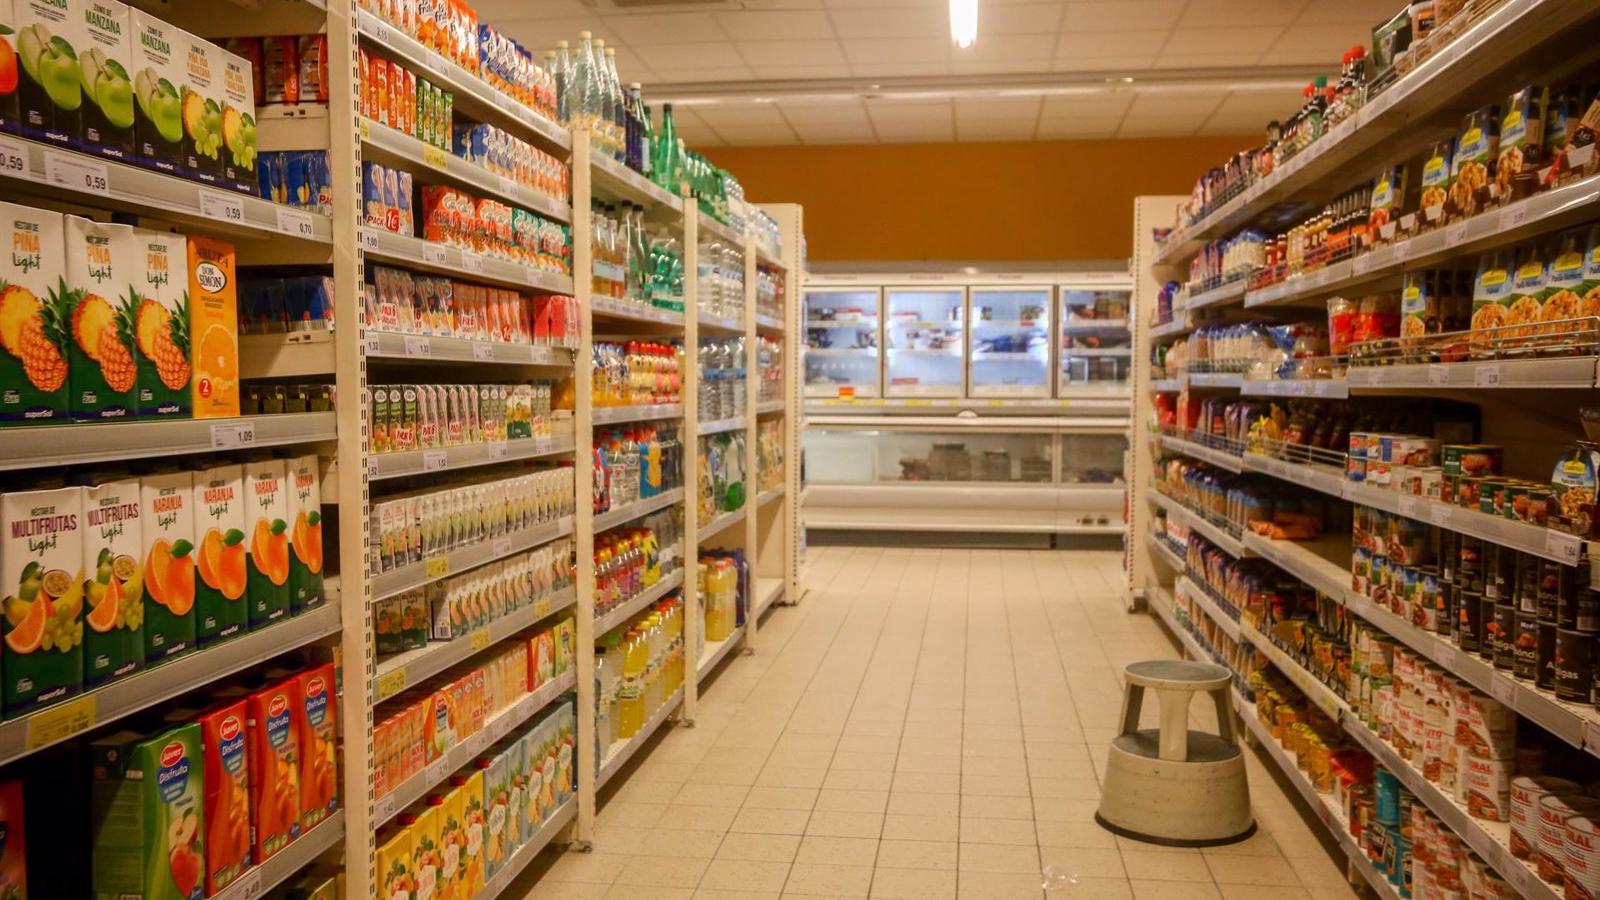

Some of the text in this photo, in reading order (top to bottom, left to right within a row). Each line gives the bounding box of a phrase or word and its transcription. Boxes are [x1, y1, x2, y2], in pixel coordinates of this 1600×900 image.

[85, 9, 121, 35] MANZANA
[141, 31, 171, 56] MANZANA
[85, 174, 106, 190] 0,59
[225, 206, 241, 220] 0,59
[367, 215, 385, 227] PACK
[13, 230, 40, 254] PIÑA
[367, 236, 378, 248] 1,00
[12, 252, 41, 274] Light
[86, 244, 112, 266] PIÑA
[147, 253, 168, 272] PIÑA
[87, 264, 112, 284] Light
[147, 271, 168, 289] Light
[202, 379, 209, 392] 2
[238, 431, 253, 443] 1,09
[204, 487, 234, 504] NARANJA
[255, 479, 278, 495] NARANJA
[153, 495, 183, 513] NARANJA
[209, 501, 228, 520] Light
[259, 493, 274, 510] Light
[88, 503, 139, 527] MULTIFRUTAS
[158, 511, 177, 531] Light
[12, 514, 77, 539] MULTIFRUTAS
[101, 522, 123, 543] Light
[28, 533, 58, 557] Light
[307, 697, 326, 711] Disfruta
[268, 716, 289, 731] Disfruta
[222, 738, 243, 756] Disfruta
[159, 764, 188, 784] Disfruta
